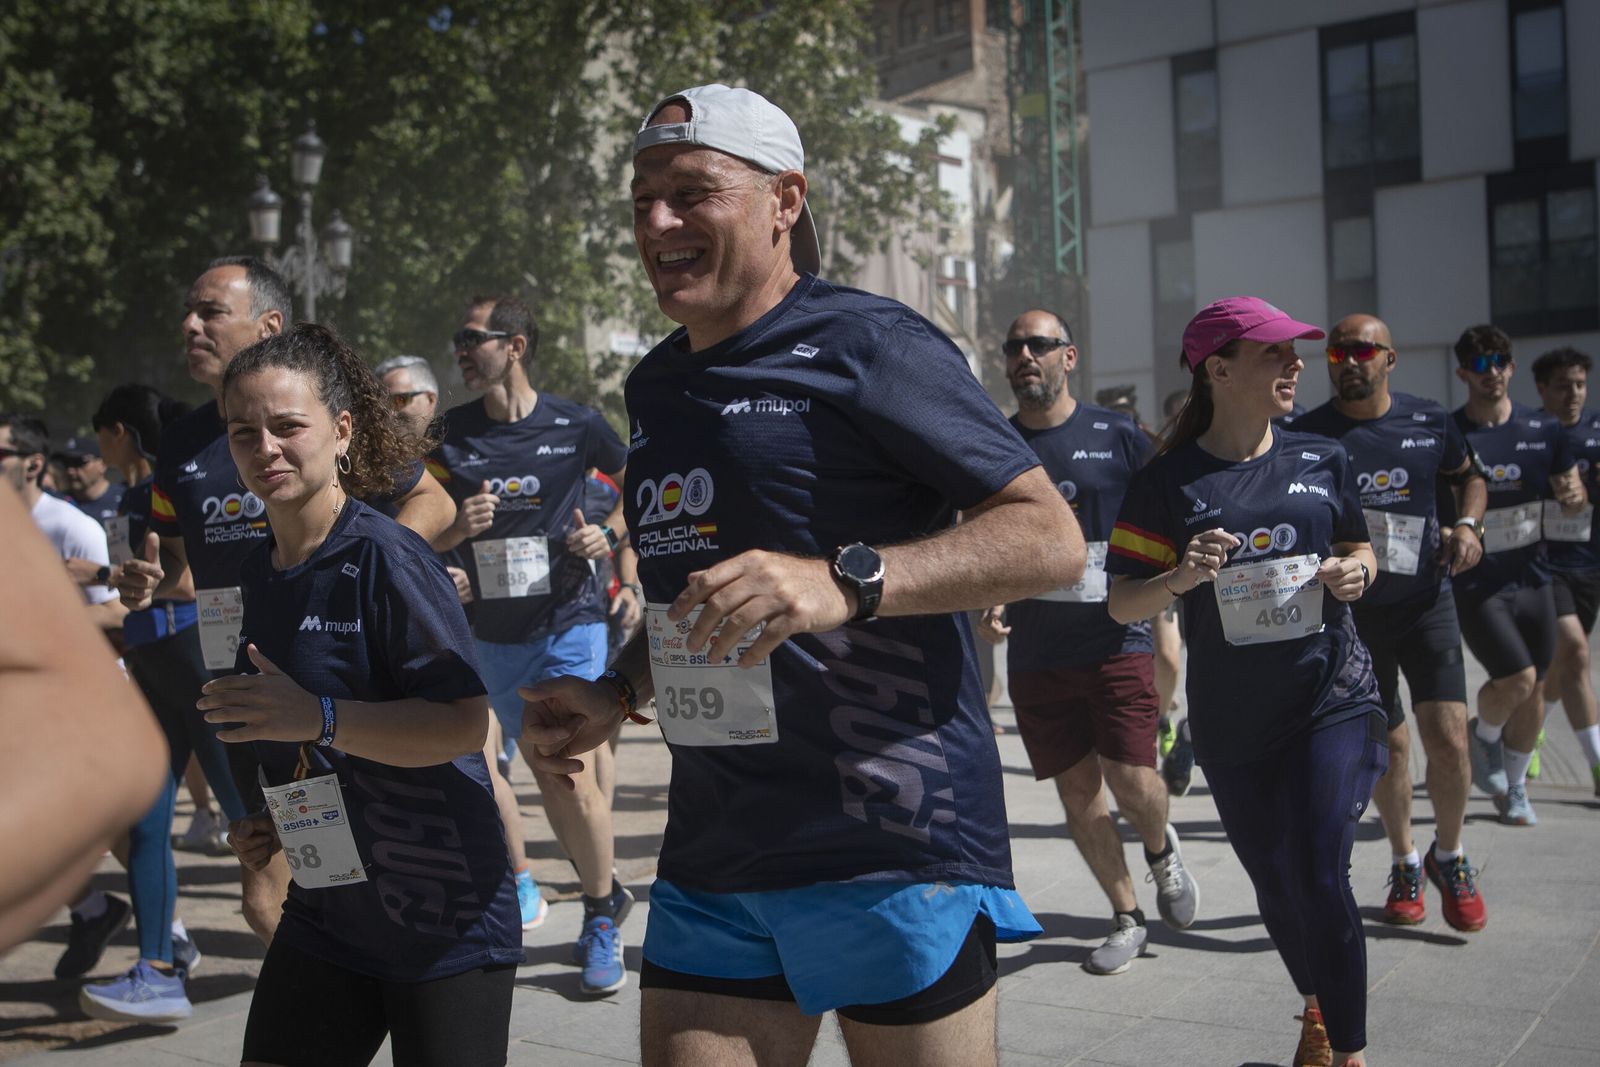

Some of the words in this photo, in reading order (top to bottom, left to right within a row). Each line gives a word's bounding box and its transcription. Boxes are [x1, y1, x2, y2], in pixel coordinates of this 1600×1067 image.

[756, 397, 811, 416] mupol
[1089, 450, 1112, 459] mupol
[1357, 467, 1409, 494] 200
[636, 467, 714, 527] 200
[202, 491, 265, 525] 200
[1184, 507, 1222, 526] Santander
[204, 522, 253, 536] POLICIA
[206, 529, 267, 544] NACIONAL
[639, 524, 700, 546] POLICIA
[639, 537, 719, 559] NACIONAL
[1231, 523, 1297, 560] 200
[497, 571, 527, 587] 838
[1220, 584, 1248, 597] alsa
[1256, 604, 1301, 628] 460
[325, 618, 361, 635] mupol
[665, 686, 724, 720] 359
